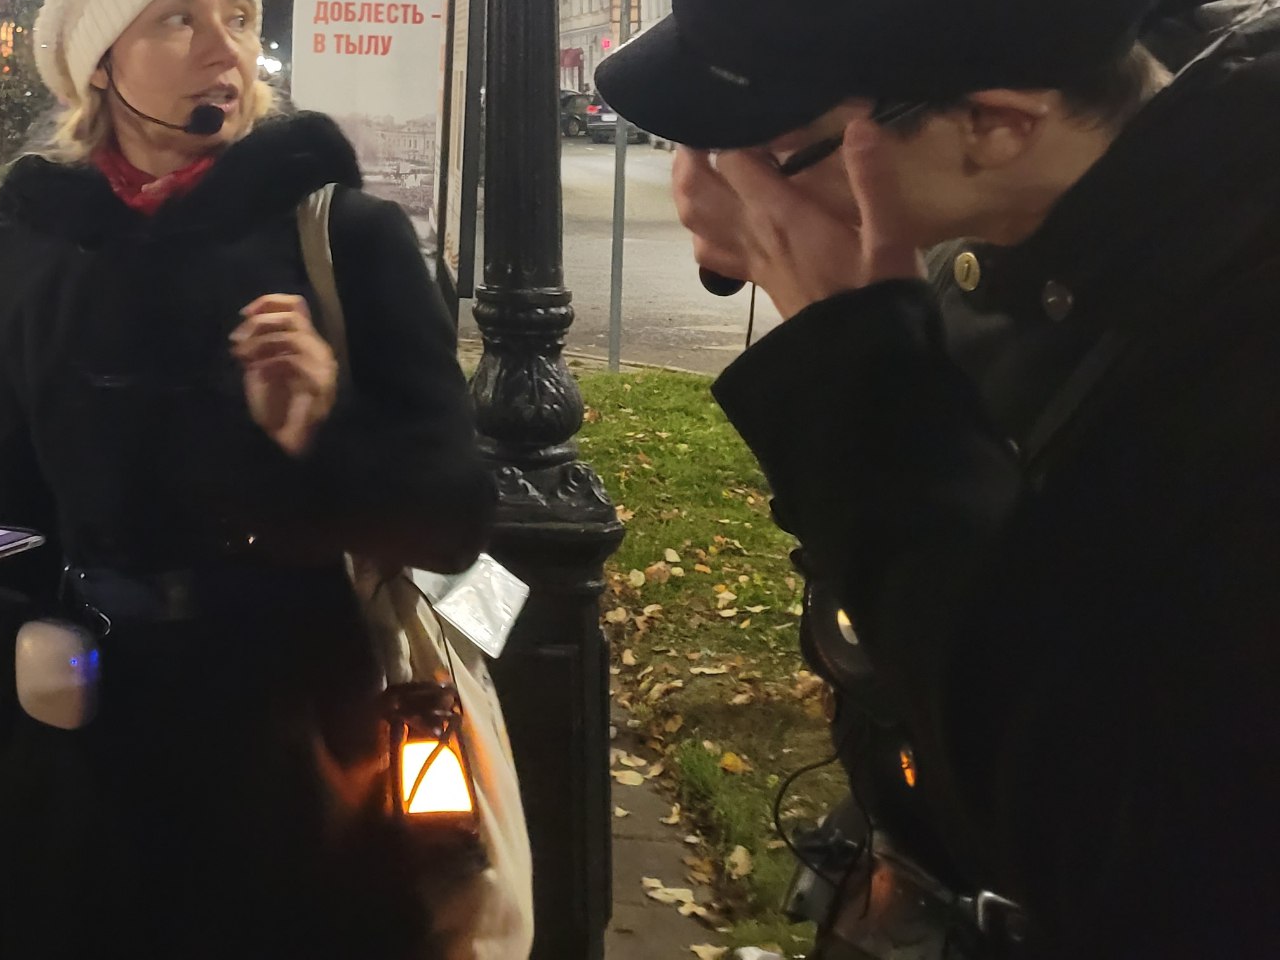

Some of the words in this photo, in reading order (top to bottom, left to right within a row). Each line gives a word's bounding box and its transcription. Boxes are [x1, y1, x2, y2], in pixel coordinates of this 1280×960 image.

[313, 1, 425, 25] ДОБЛЕСТЬ
[313, 33, 326, 54] В
[333, 34, 393, 56] ТЫЛУ
